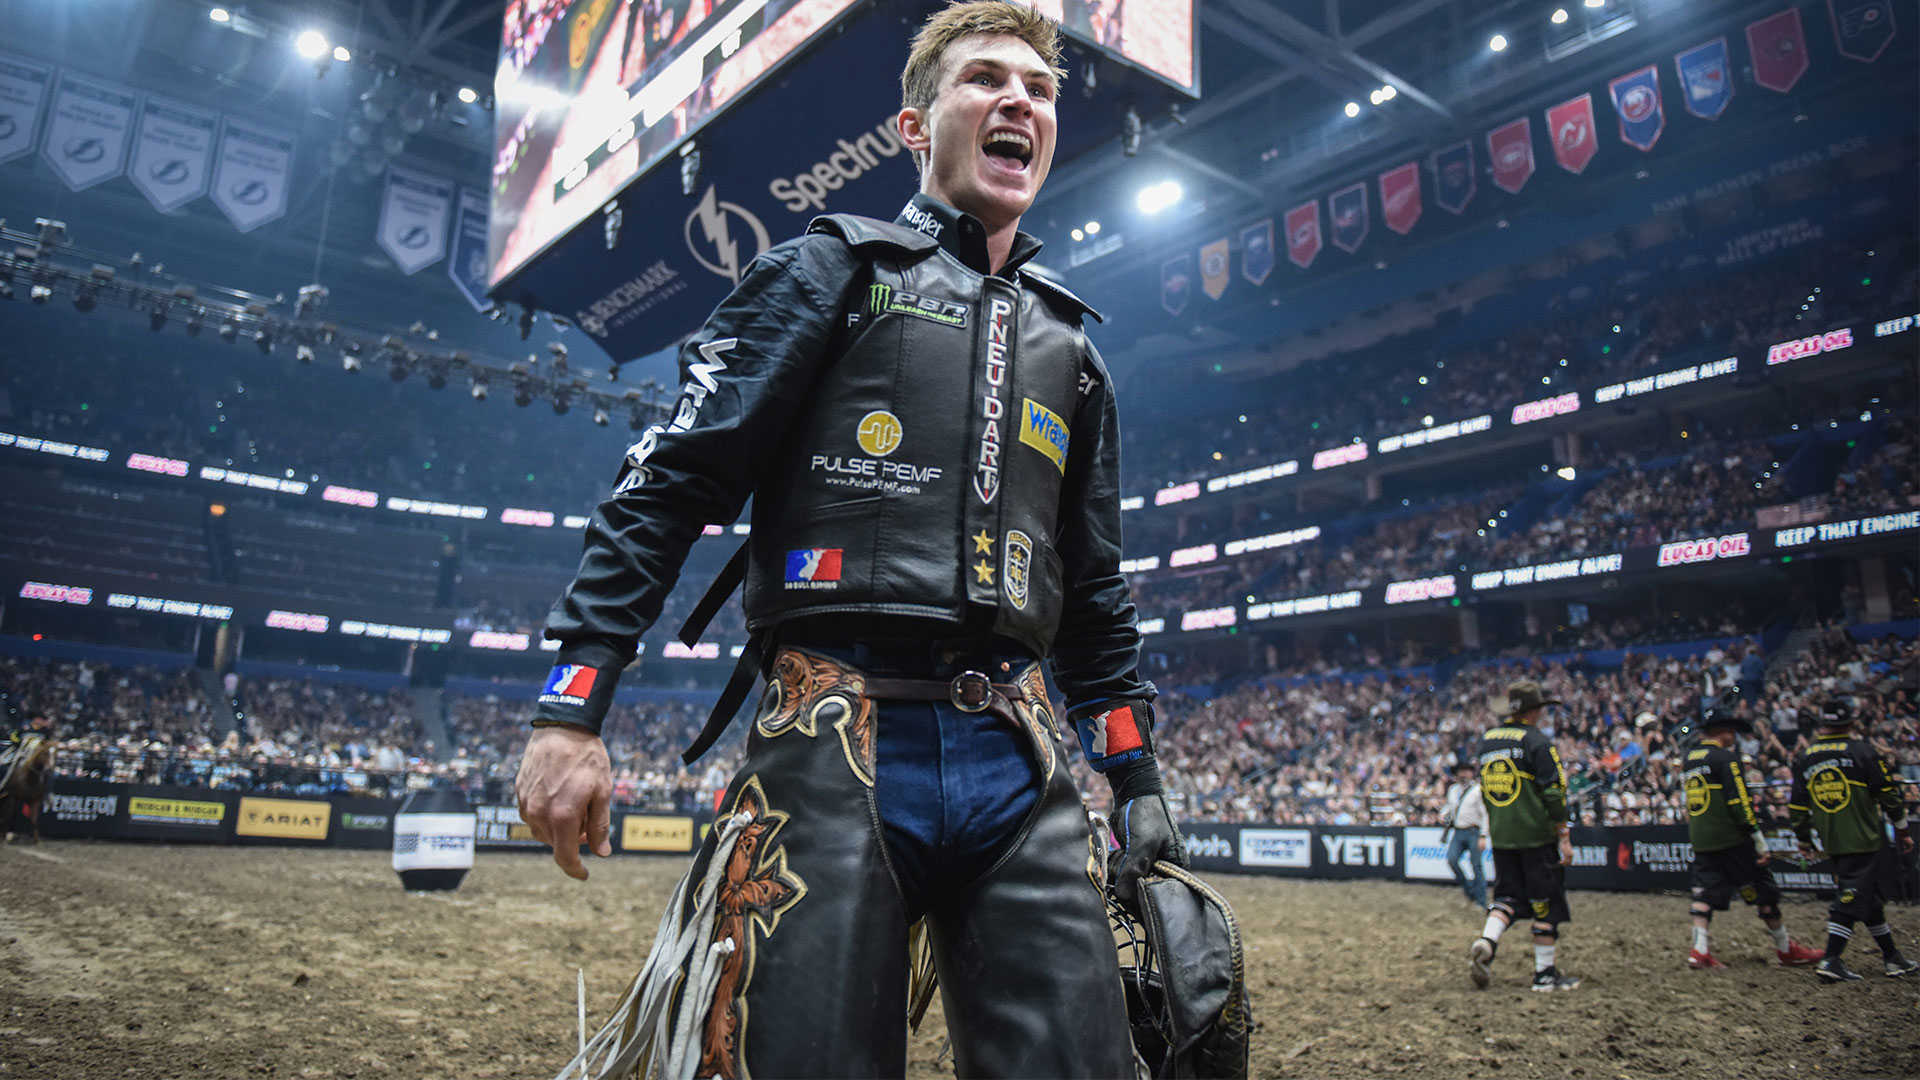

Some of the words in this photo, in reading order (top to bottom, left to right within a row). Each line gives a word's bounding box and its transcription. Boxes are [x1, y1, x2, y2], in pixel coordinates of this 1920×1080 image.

[770, 115, 905, 212] Spectru
[889, 304, 927, 316] UNLEASH
[893, 291, 967, 316] PBR
[1875, 317, 1913, 337] KEEP
[1767, 335, 1823, 365] LUCAS
[1823, 328, 1853, 352] OIL
[811, 455, 877, 476] PULSE
[882, 461, 943, 482] PEMF
[825, 477, 921, 494] www.PulsePEMF.com
[1775, 527, 1816, 547] KEEP
[1817, 520, 1859, 541] THAT
[1861, 511, 1920, 535] ENGINE
[1658, 538, 1718, 567] LUCAS
[1716, 533, 1750, 557] OIL
[43, 793, 117, 817] PENDLETON
[264, 813, 323, 826] ARIAT
[643, 830, 687, 839] ARIAT
[1321, 835, 1397, 867] YETI
[1633, 840, 1696, 864] PENDLETO
